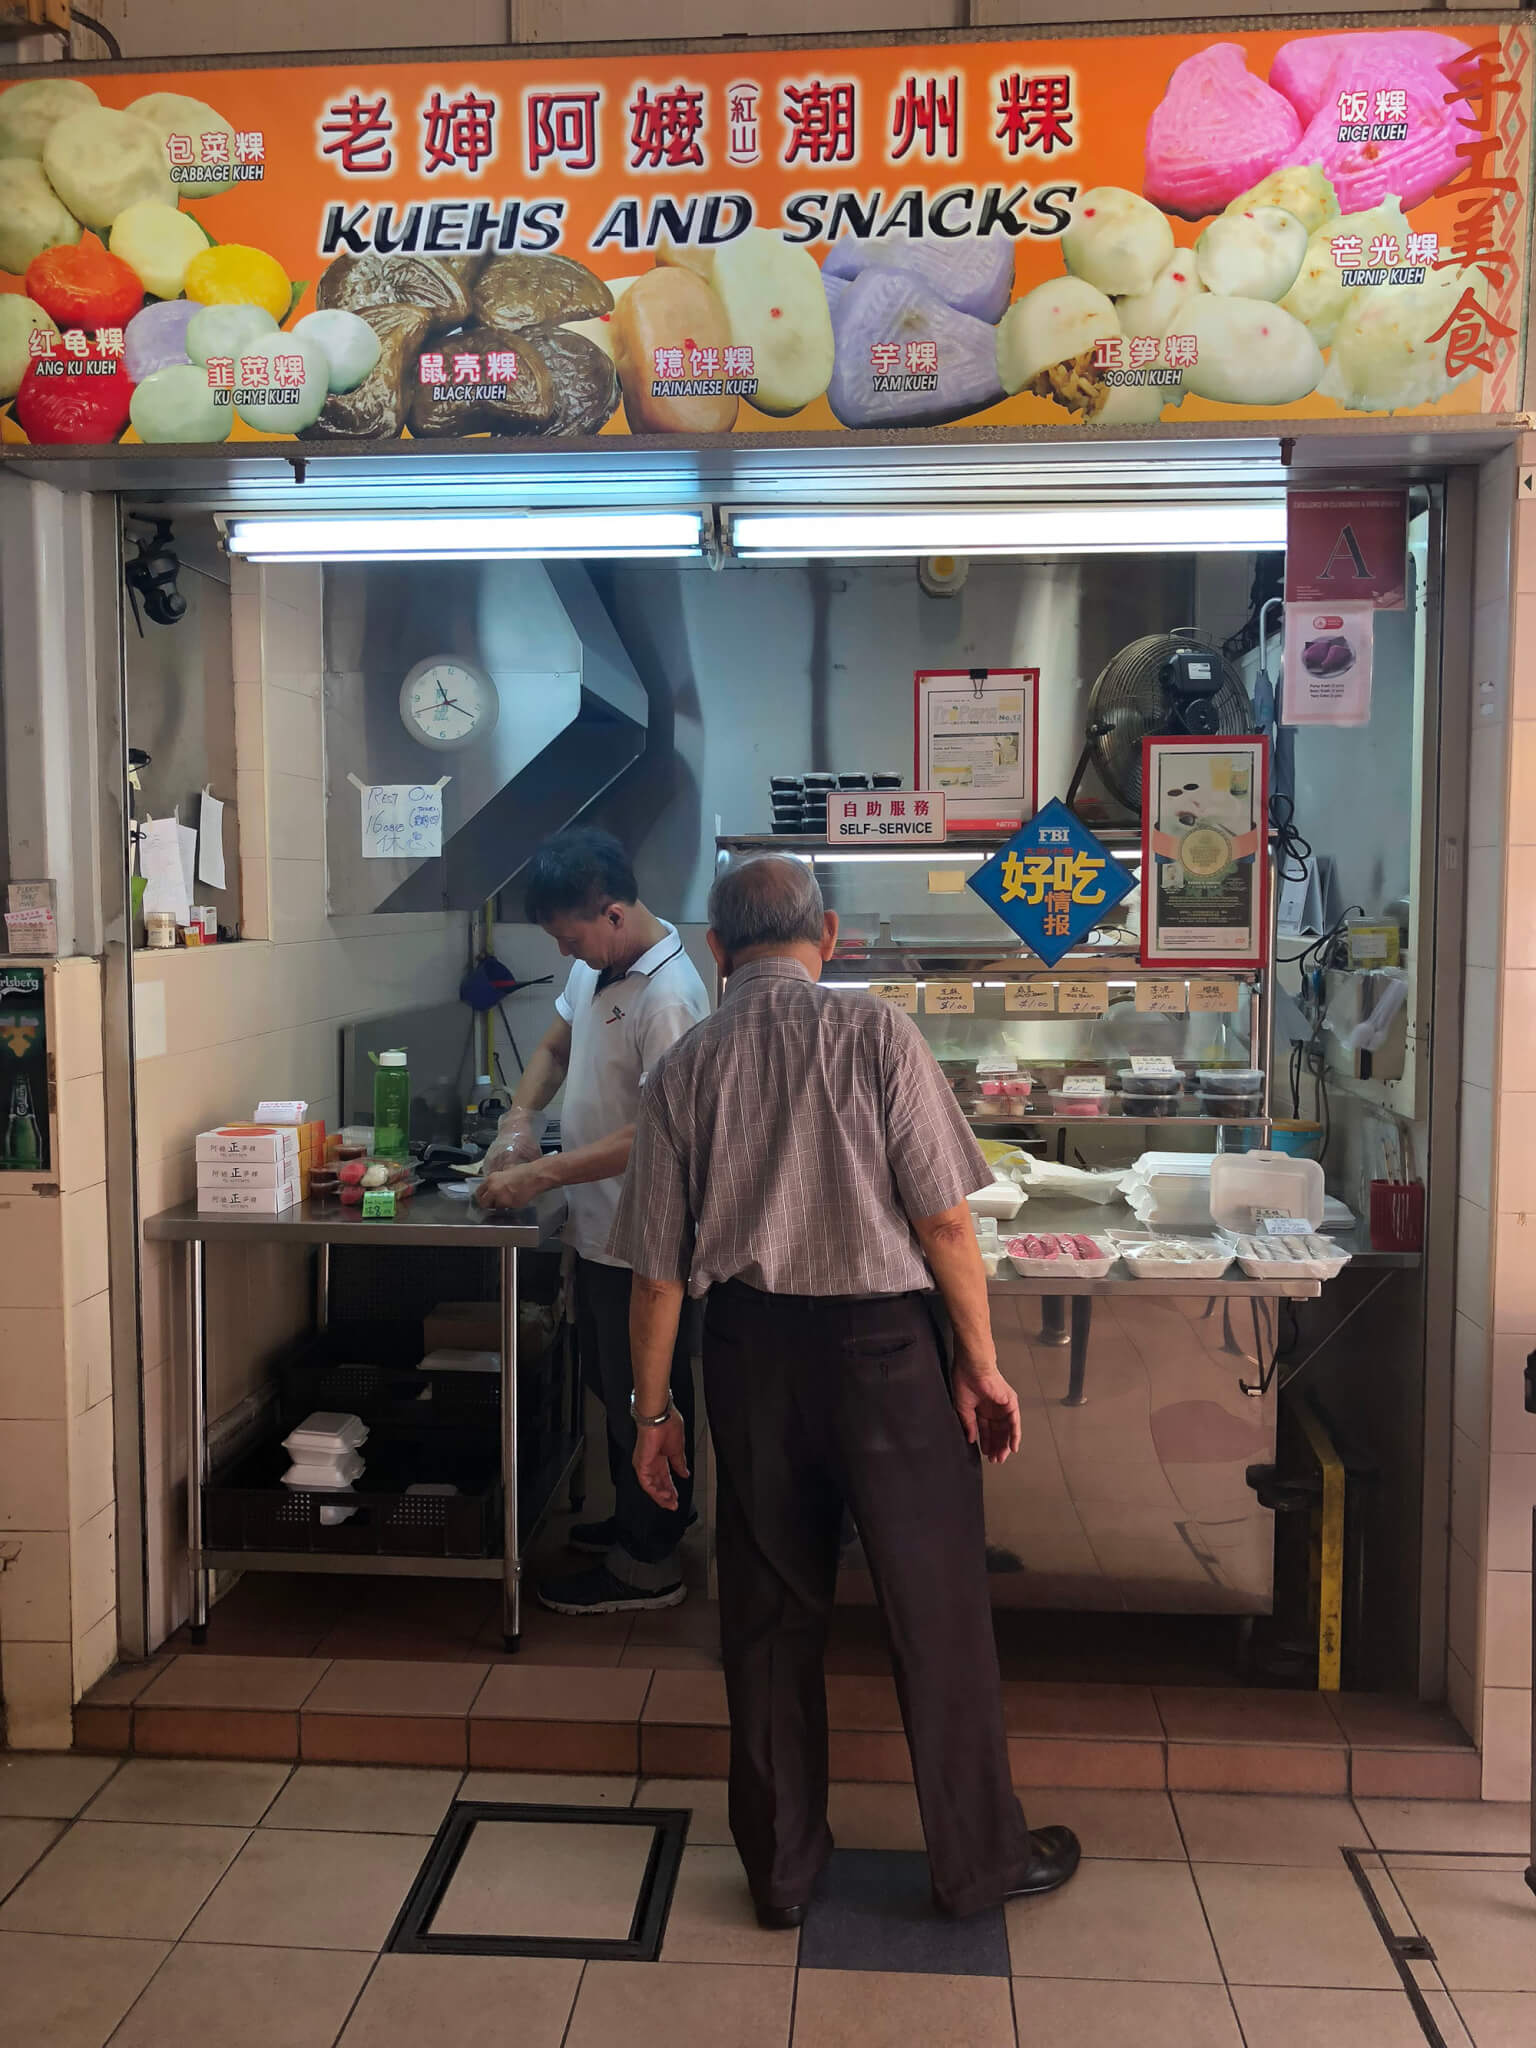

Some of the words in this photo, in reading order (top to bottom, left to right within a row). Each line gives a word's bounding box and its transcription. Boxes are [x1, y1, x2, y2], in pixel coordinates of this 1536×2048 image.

[1337, 89, 1408, 123] 饭粿
[1337, 124, 1370, 142] RICE
[1371, 123, 1408, 141] KUEH
[166, 131, 265, 165] 包菜粿
[170, 165, 230, 182] CABBAGE
[231, 164, 265, 181] KUEH
[1424, 41, 1522, 377] 手工美食
[322, 202, 565, 254] KUEHS
[592, 194, 753, 250] AND
[783, 186, 1078, 244] SNACKS
[1331, 233, 1439, 267] 芒光粿
[1342, 268, 1388, 287] TURNIP
[1389, 267, 1426, 285] KUEH
[871, 341, 938, 374] 芋粿
[35, 360, 65, 376] ANG
[66, 360, 84, 376] KU
[85, 360, 117, 376] KUEH
[652, 380, 722, 397] HAINANESE
[725, 378, 759, 395] KUEH
[873, 375, 903, 392] YAM
[904, 374, 938, 391] KUEH
[1105, 370, 1146, 387] SOON
[1148, 369, 1183, 385] KUEH
[214, 389, 231, 405] KU
[233, 389, 266, 405] CHYE
[268, 388, 300, 404] KUEH
[433, 385, 473, 401] BLACK
[475, 384, 507, 400] KUEH
[1315, 524, 1377, 580] A
[843, 800, 929, 818] 自助服務
[839, 822, 933, 835] SELF-SERVICE
[1038, 829, 1070, 842] FBI
[1001, 851, 1106, 905] 好吃
[1043, 891, 1072, 936] 情报
[0, 973, 39, 991] rlsberg
